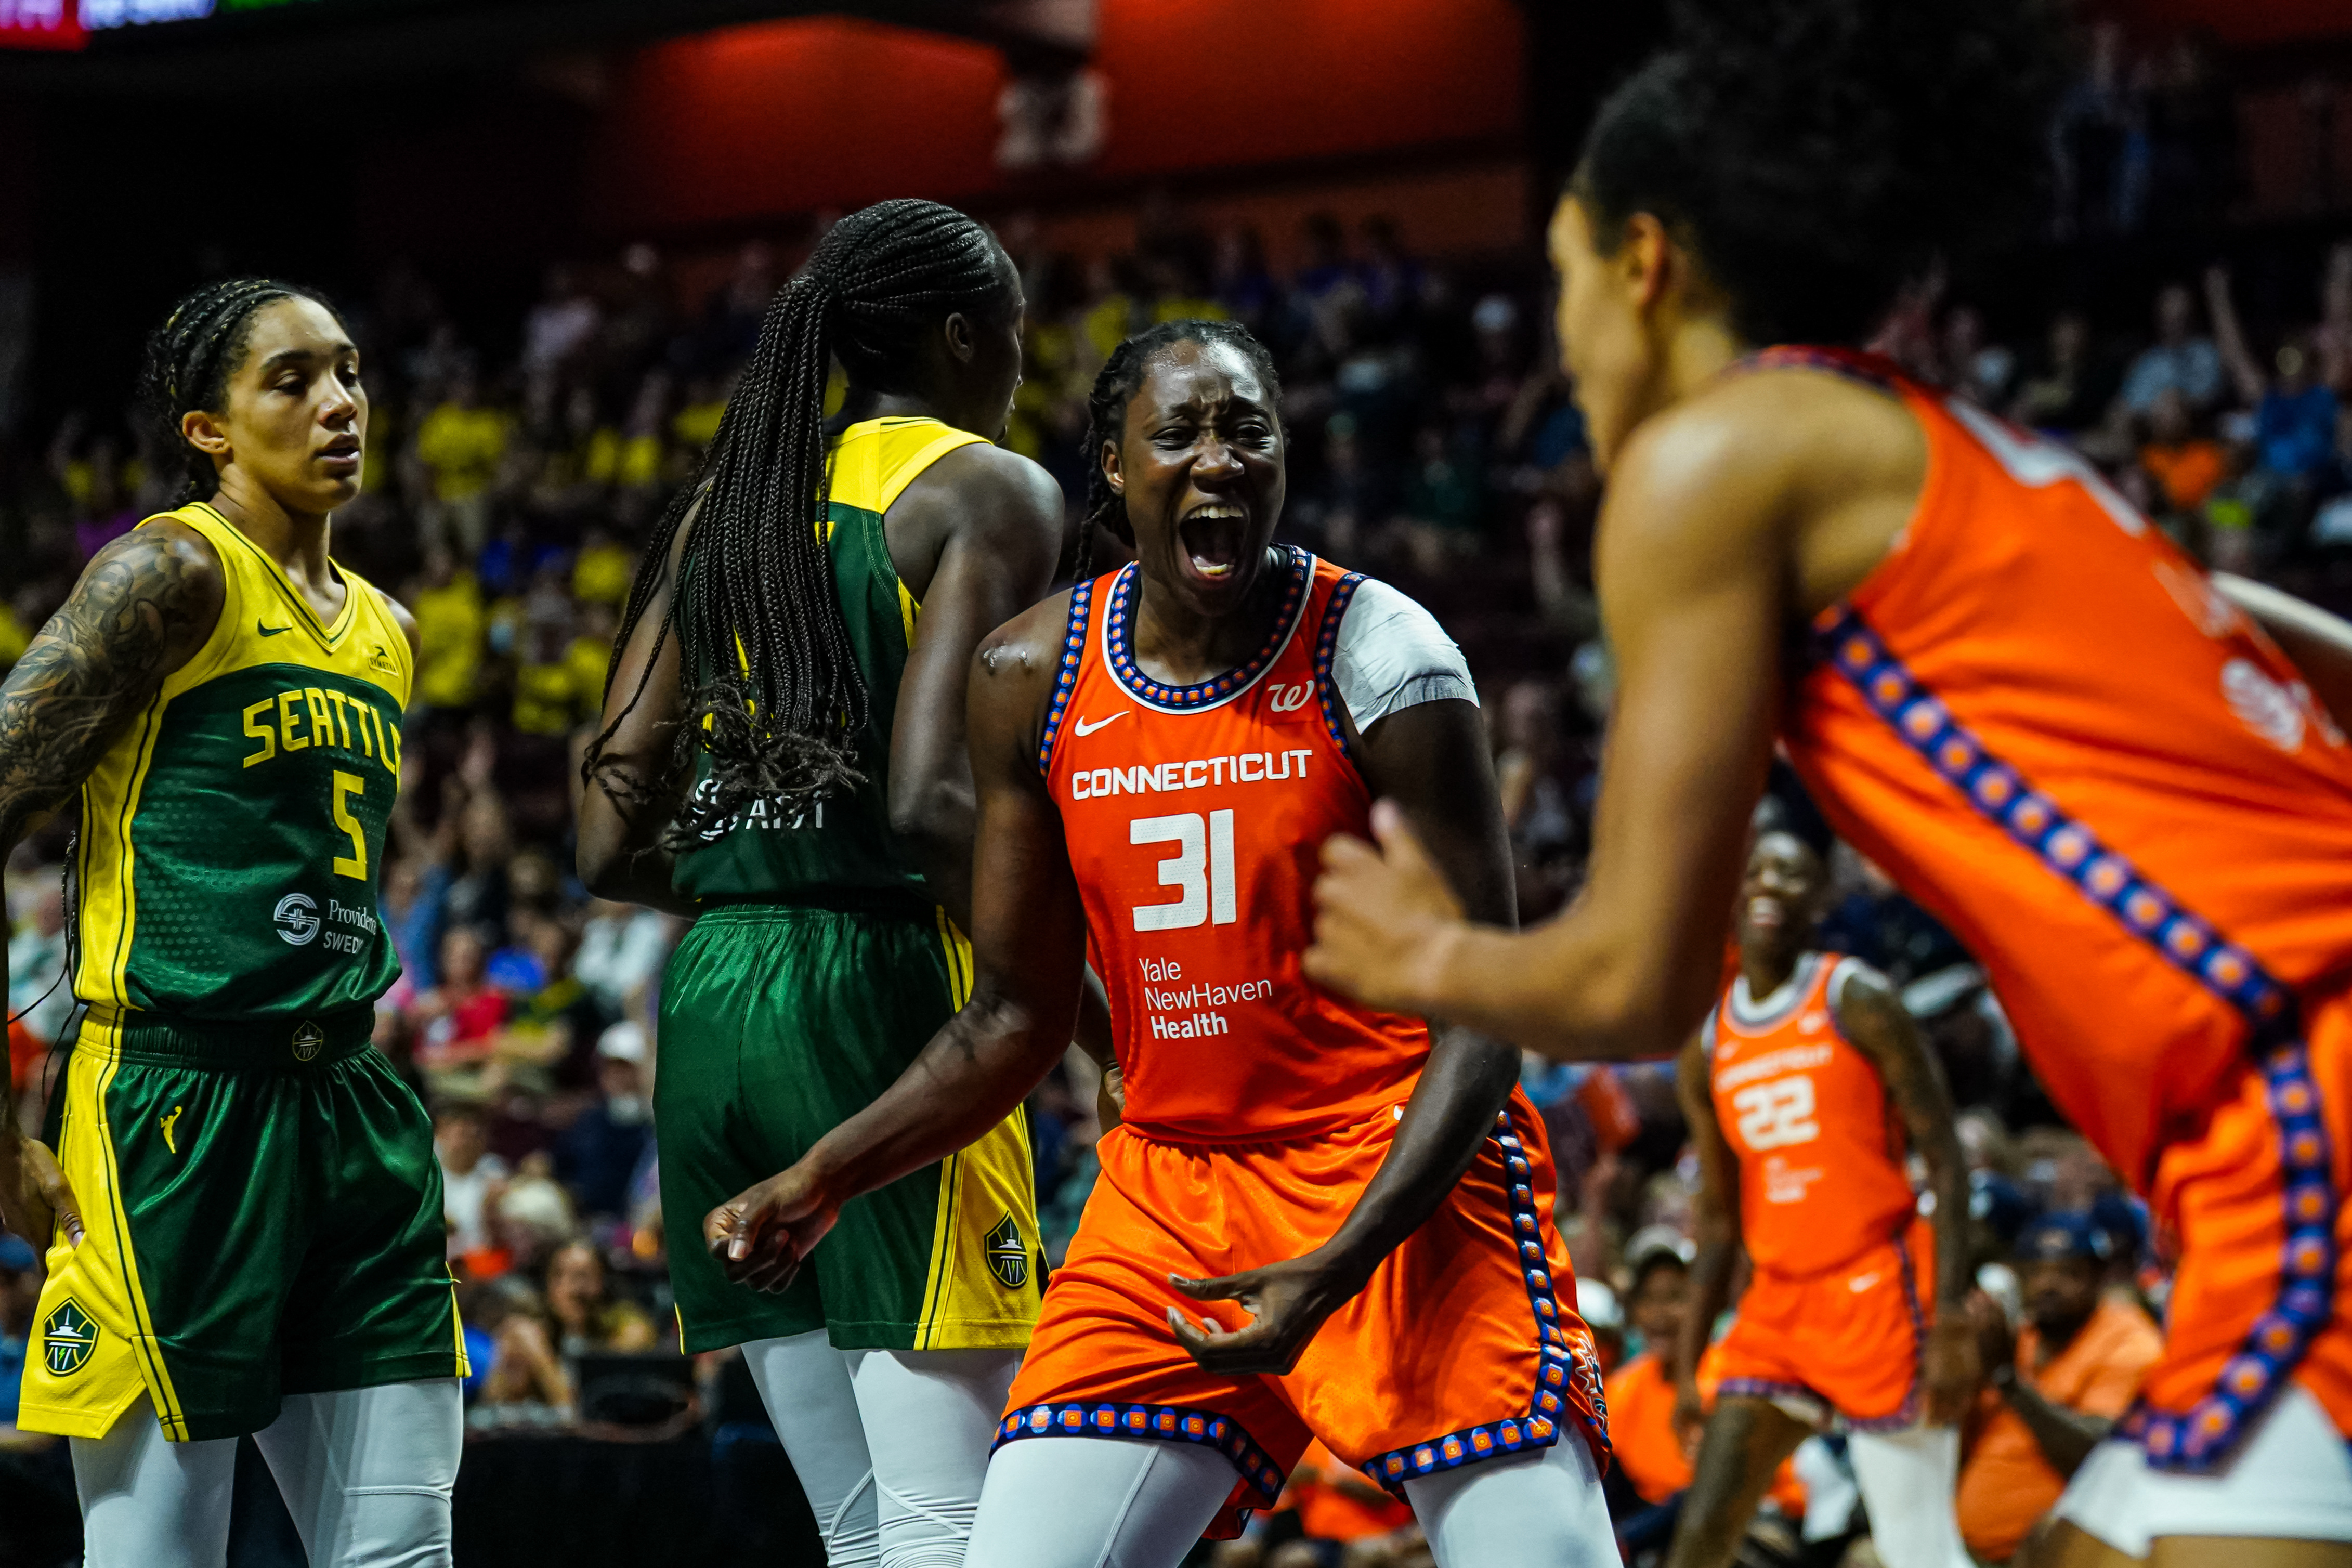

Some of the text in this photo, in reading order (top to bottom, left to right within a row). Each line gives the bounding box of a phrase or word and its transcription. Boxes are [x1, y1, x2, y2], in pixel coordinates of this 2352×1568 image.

[1072, 749, 1312, 800] CONNECTICUT
[333, 770, 367, 881] 5
[1130, 808, 1237, 932] 31
[1139, 957, 1182, 982] Yale
[1144, 979, 1272, 1011] NewHaven
[1150, 1011, 1229, 1039] Health
[1732, 1074, 1820, 1152] 22
